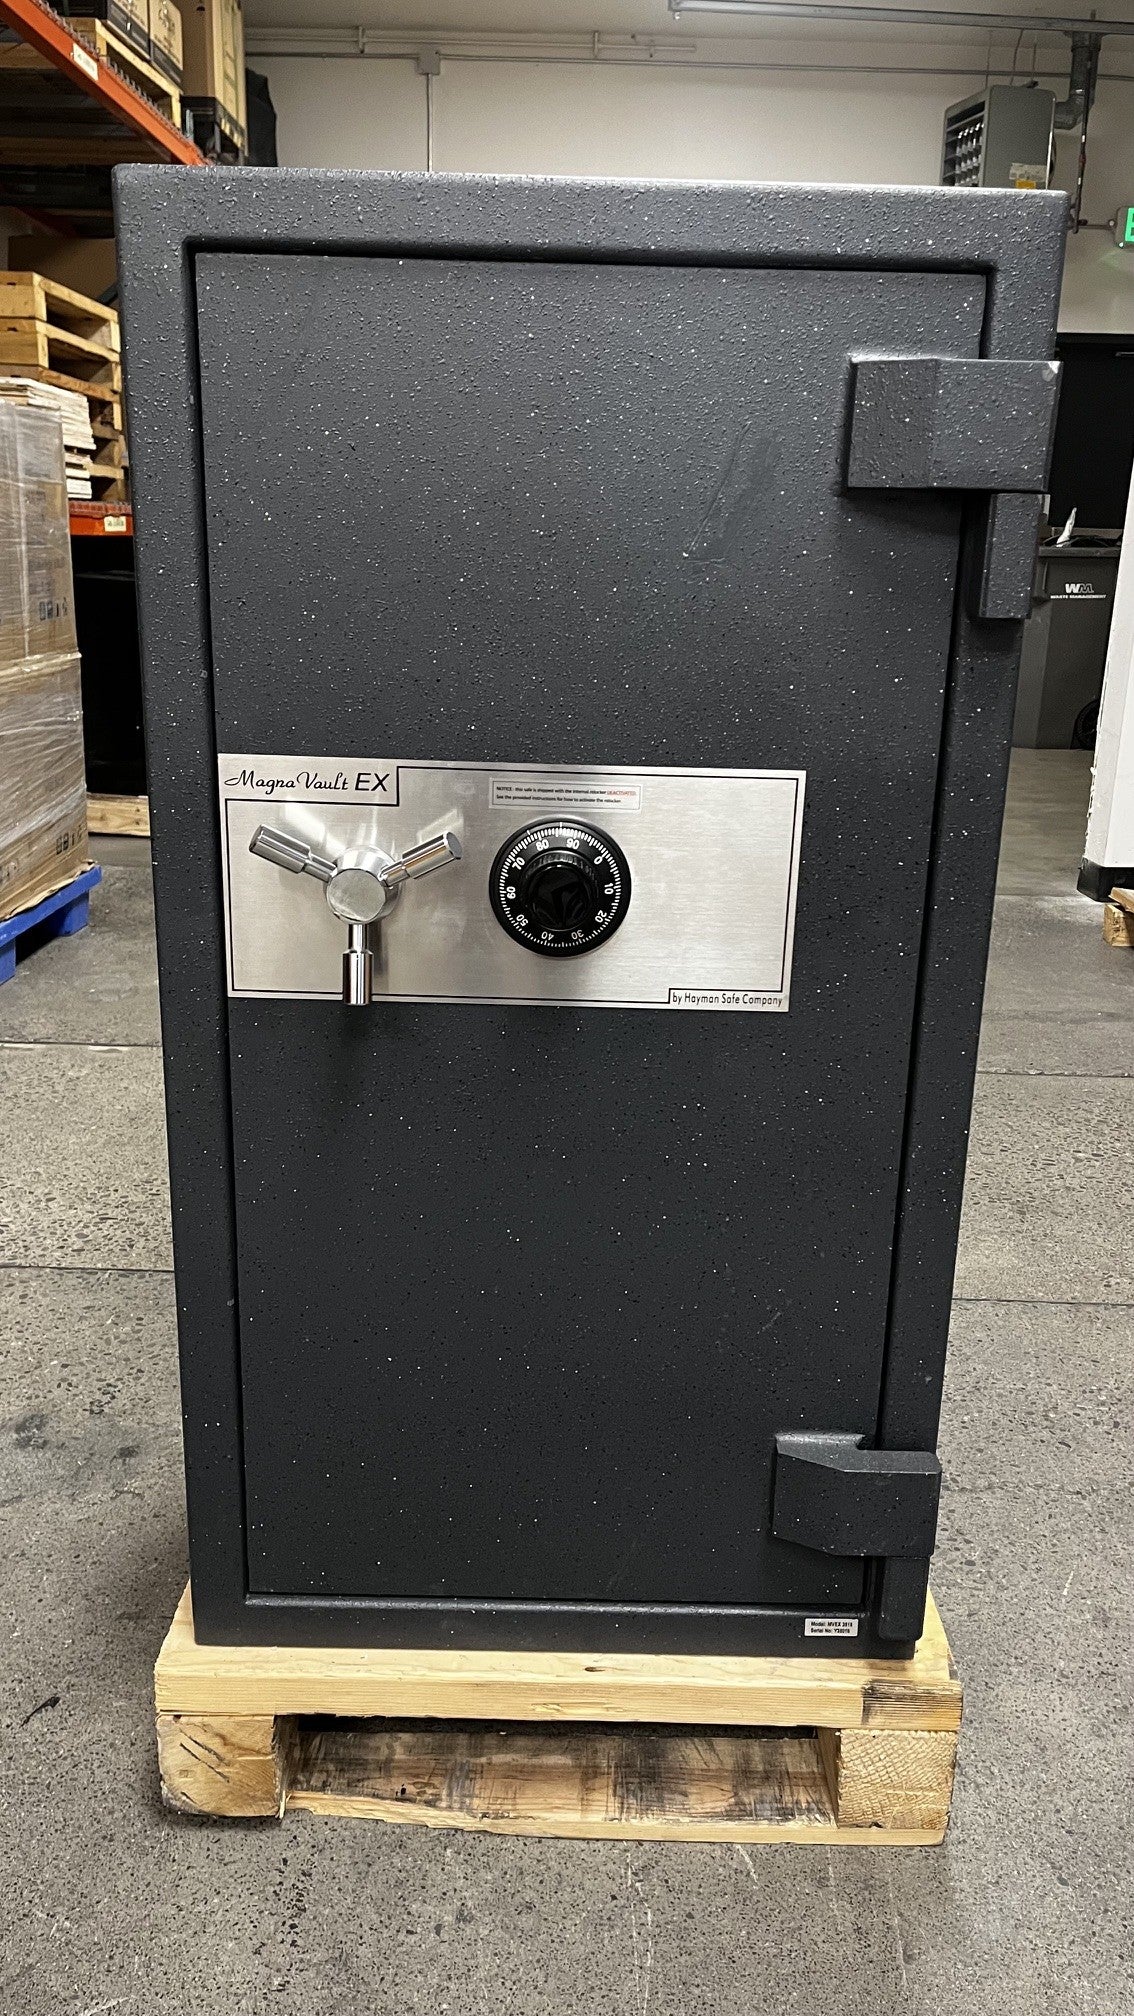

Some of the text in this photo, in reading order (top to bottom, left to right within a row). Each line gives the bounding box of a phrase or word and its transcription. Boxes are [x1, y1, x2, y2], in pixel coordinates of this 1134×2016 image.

[1065, 583, 1094, 594] WM
[355, 772, 390, 792] EX
[536, 839, 550, 851] 80
[566, 838, 580, 850] 90
[512, 857, 526, 870] 70
[594, 855, 602, 865] 0
[506, 886, 516, 900] 60
[604, 883, 614, 894] 10
[516, 914, 528, 926] 50
[594, 910, 608, 923] 20
[541, 931, 554, 941] 40
[571, 929, 584, 940] 30
[672, 992, 783, 1007] by Hayman Safe Company
